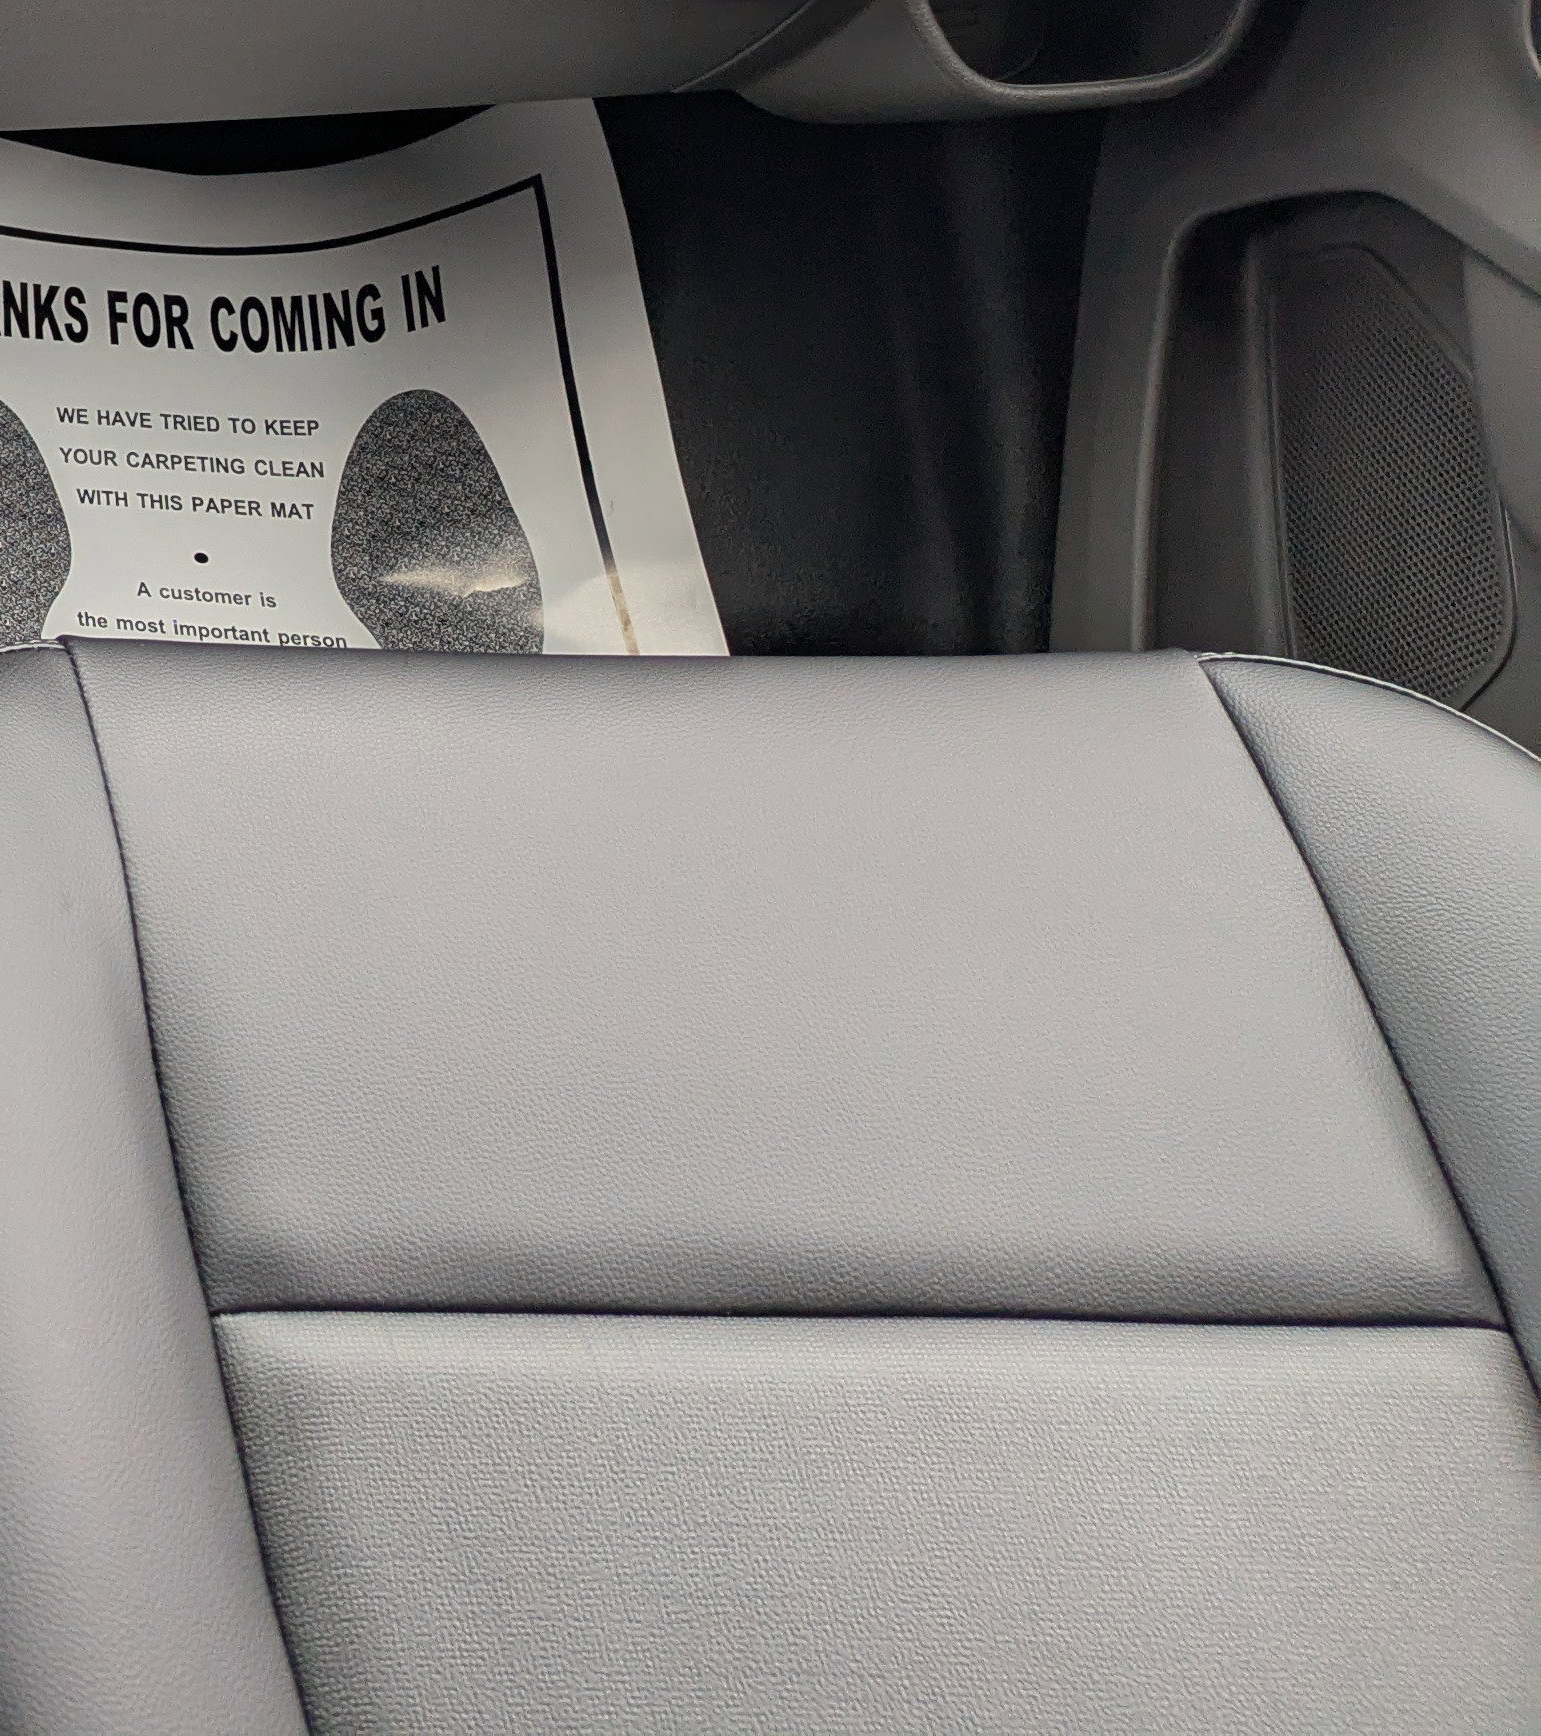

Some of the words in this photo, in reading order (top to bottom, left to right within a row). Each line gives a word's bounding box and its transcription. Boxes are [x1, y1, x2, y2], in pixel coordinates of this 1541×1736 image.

[107, 289, 194, 351] FOR
[210, 282, 386, 354] COMING
[401, 264, 447, 333] IN
[56, 407, 89, 425] WE
[97, 410, 152, 429] HAVE
[160, 413, 220, 432] TRIED
[228, 417, 256, 435] TO
[264, 419, 320, 436] KEEP
[59, 447, 117, 466] YOUR
[126, 451, 245, 475] CARPETING
[254, 459, 325, 478] CLEAN
[76, 488, 129, 507] WITH
[136, 492, 183, 511] THIS
[192, 496, 263, 517] PAPER
[270, 501, 314, 520] MAT
[137, 581, 152, 598] A
[159, 586, 252, 606] customer
[259, 591, 277, 609] is
[77, 611, 108, 629] the
[116, 617, 166, 635] most
[173, 619, 271, 644] important
[278, 630, 348, 649] person
